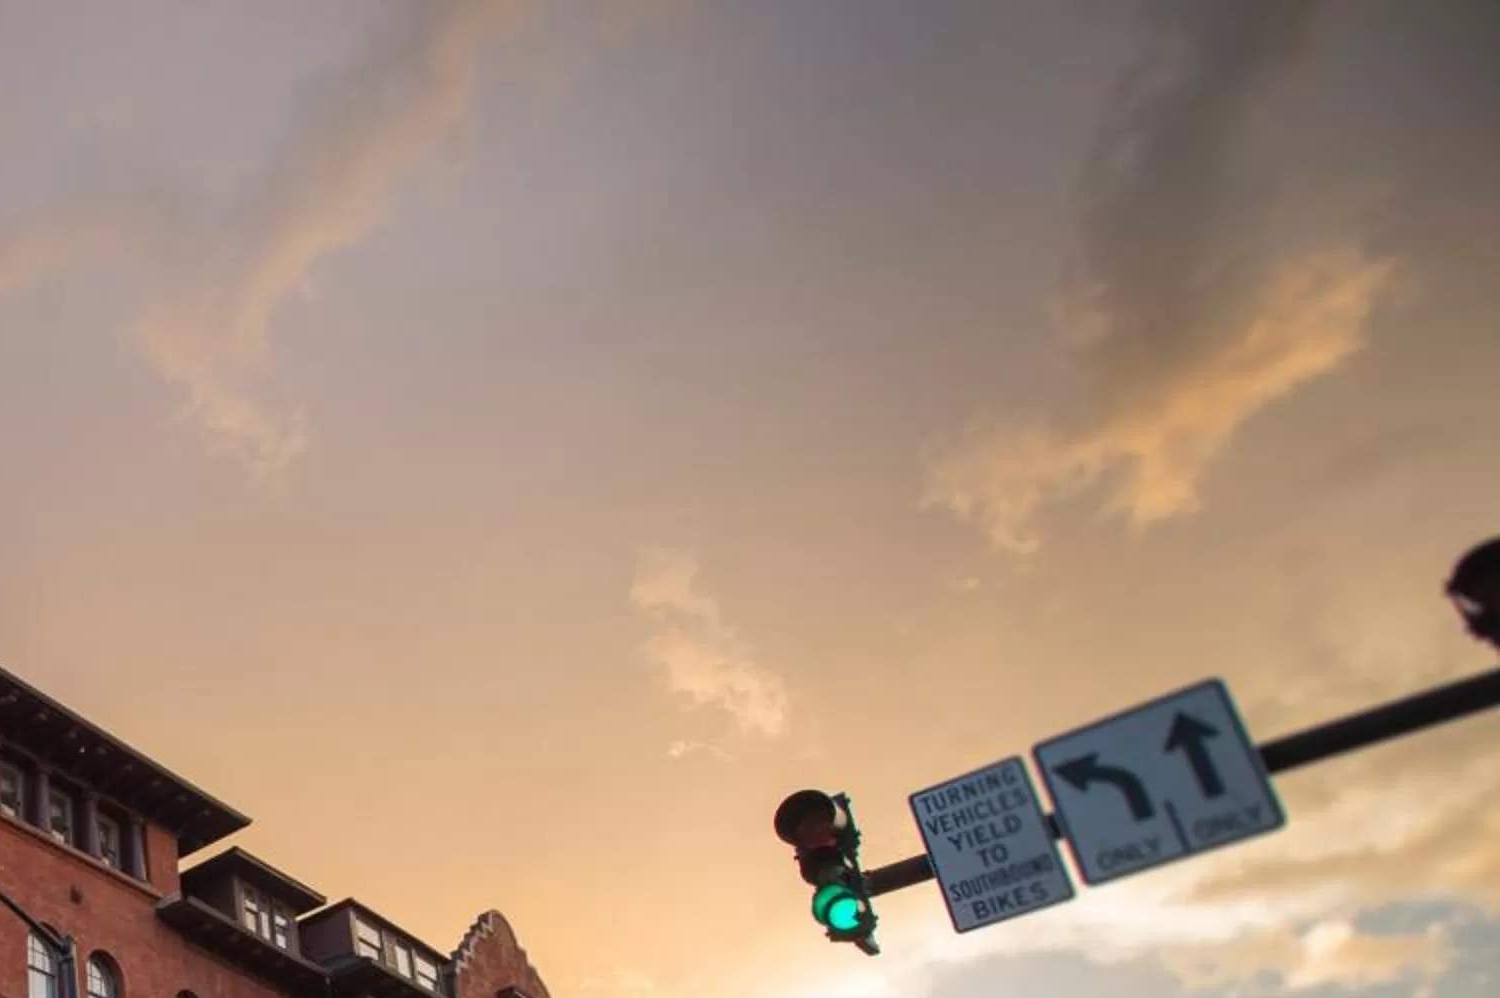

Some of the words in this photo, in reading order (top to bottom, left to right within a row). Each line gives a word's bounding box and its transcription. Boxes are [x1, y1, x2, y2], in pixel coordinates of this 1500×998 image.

[921, 765, 1017, 813] TURNING
[925, 787, 1028, 836] VEHICLES
[948, 814, 1022, 852] YIELD
[976, 843, 1009, 868] TO
[972, 881, 1049, 920] BIKES
